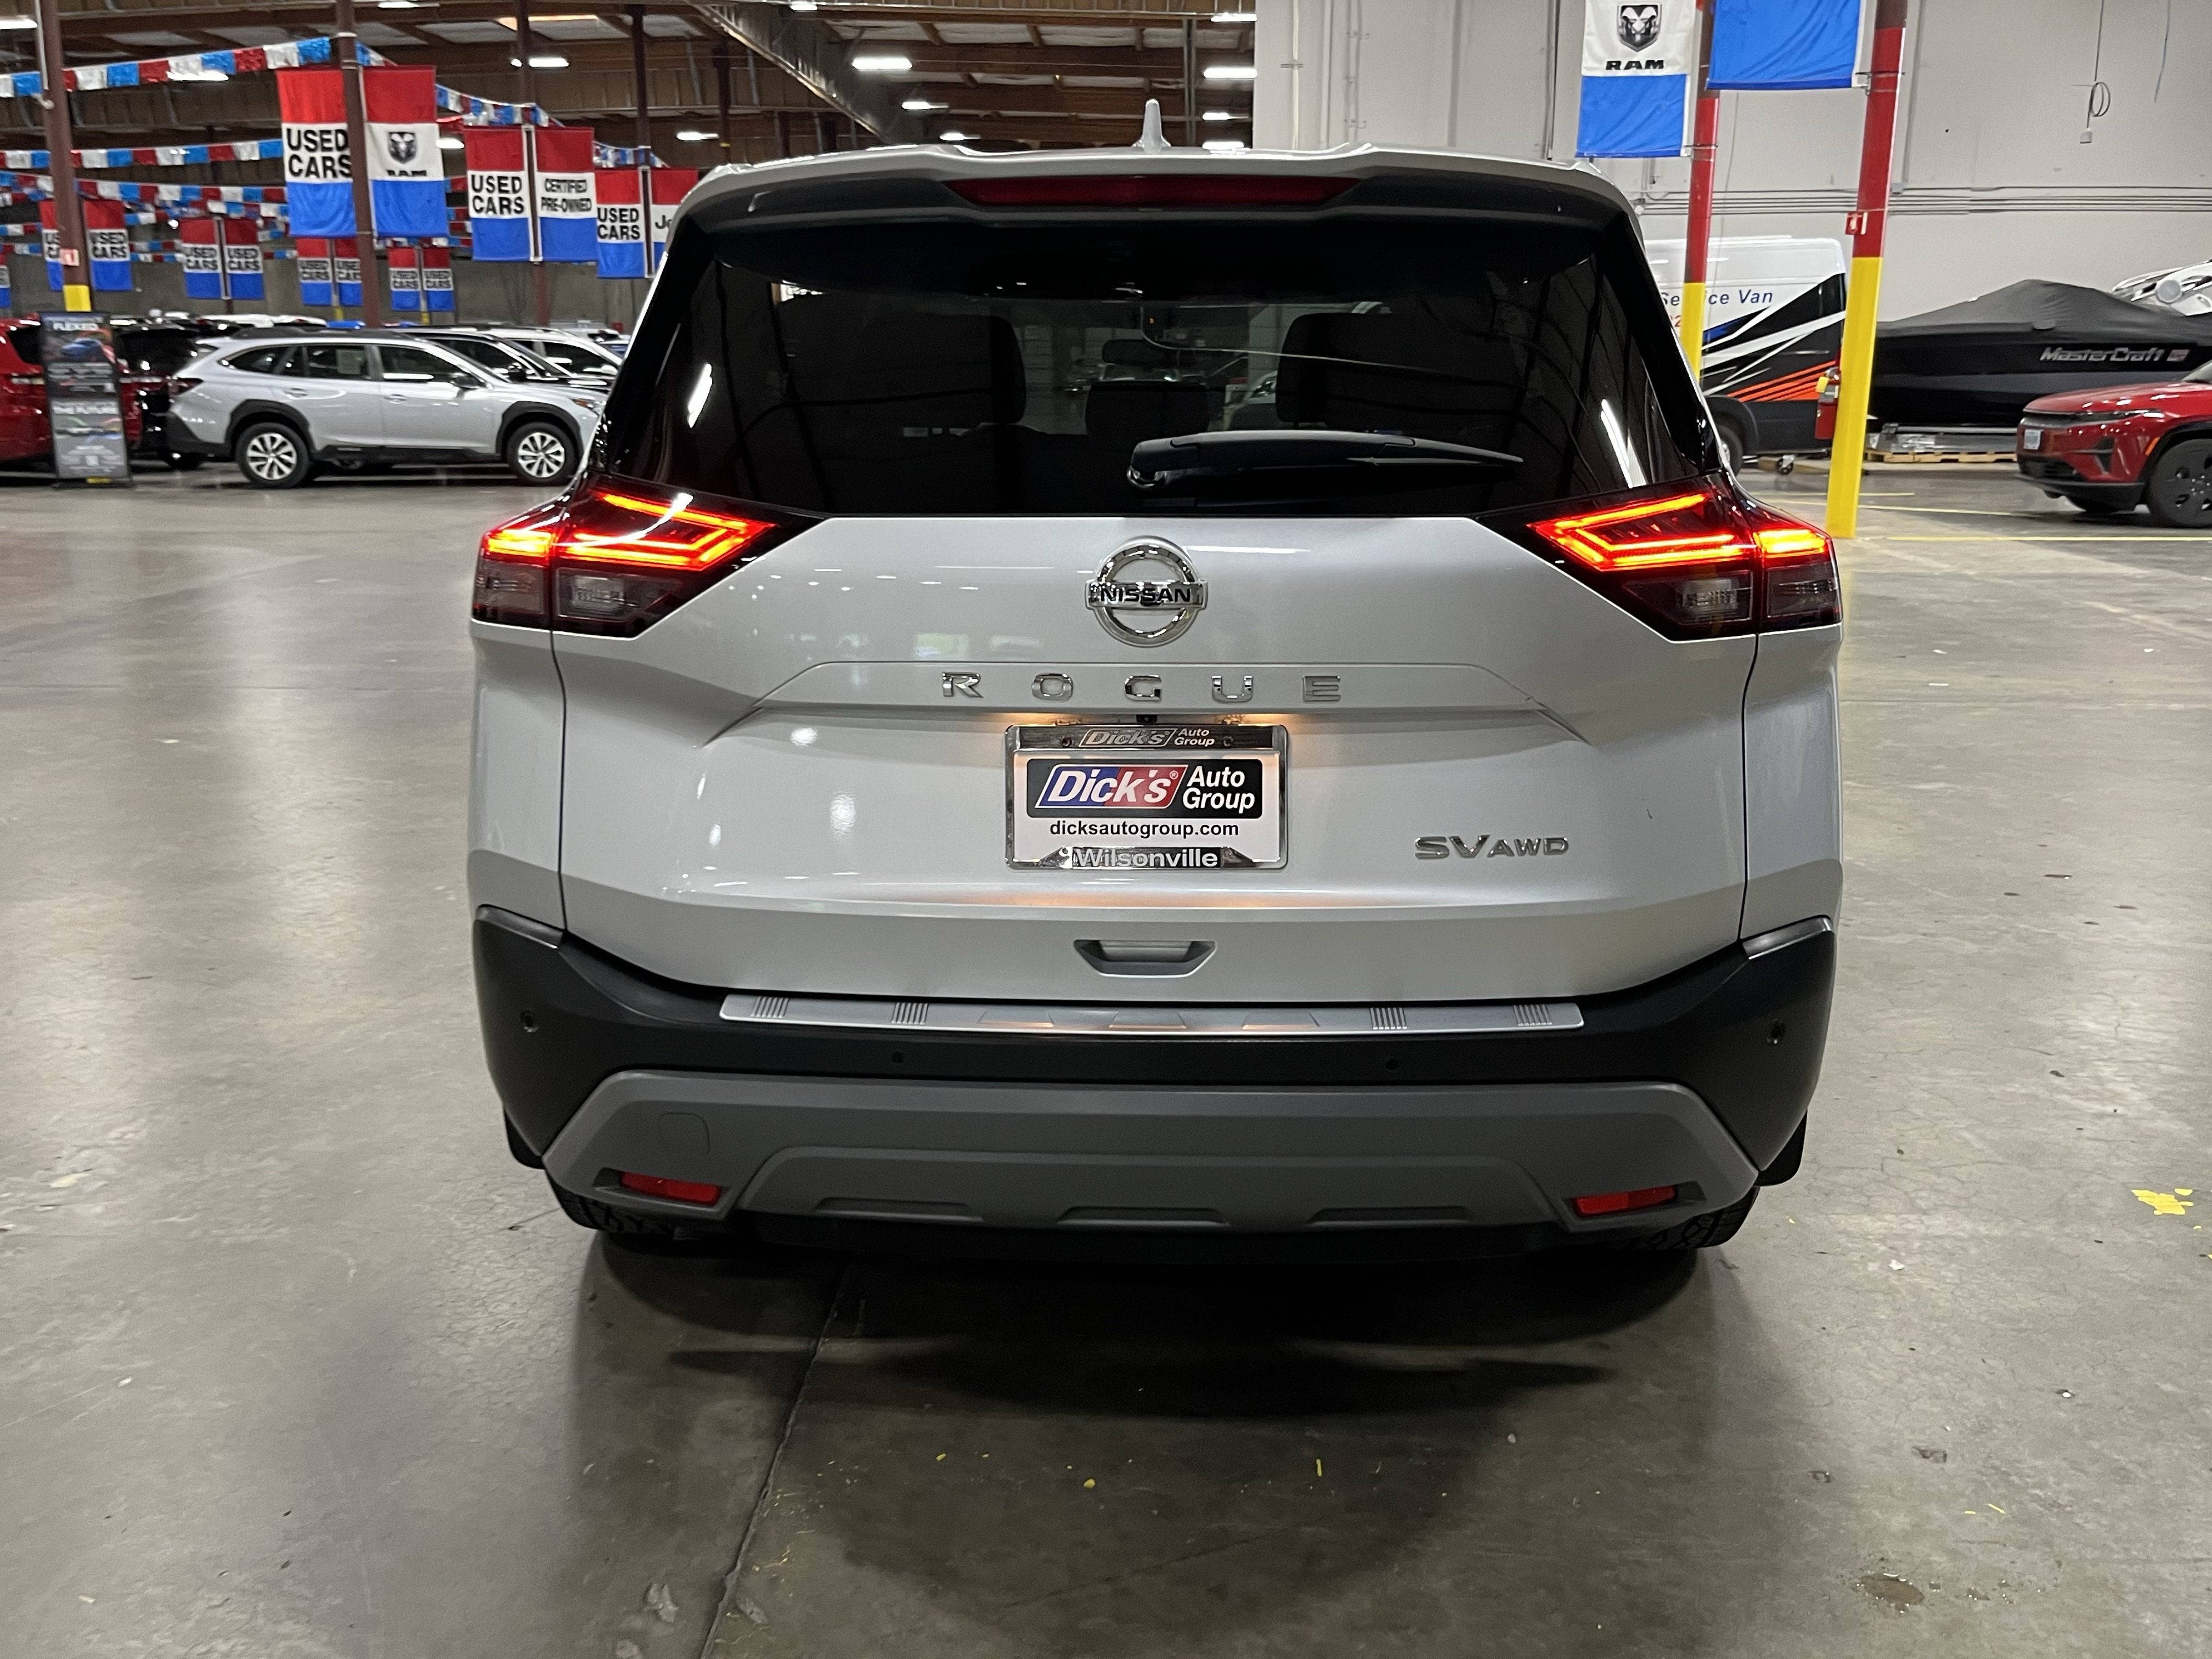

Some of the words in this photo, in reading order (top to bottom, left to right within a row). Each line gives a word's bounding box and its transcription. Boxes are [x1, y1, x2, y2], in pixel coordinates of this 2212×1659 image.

[1605, 60, 1664, 70] RAM
[286, 128, 348, 153] USED
[288, 154, 352, 178] CARS
[471, 174, 522, 194] USED
[545, 178, 587, 193] CERTIFIED
[472, 195, 524, 215] CARS
[541, 196, 592, 212] PRE-OWNED
[597, 207, 640, 223] USED
[597, 224, 640, 240] CARS
[227, 248, 259, 259] USED
[228, 260, 260, 270] CARS
[1739, 289, 1773, 304] Van
[2040, 347, 2165, 362] MasterCraft
[1100, 588, 1190, 603] NISSAN
[941, 671, 1342, 703] ROGUE
[1178, 728, 1210, 737] Auto
[1173, 737, 1215, 747] Group
[1187, 766, 1245, 788] Auto
[1182, 787, 1255, 814] Group
[1049, 820, 1239, 839] dicksautogroup.com
[1074, 848, 1218, 868] Wilsonville
